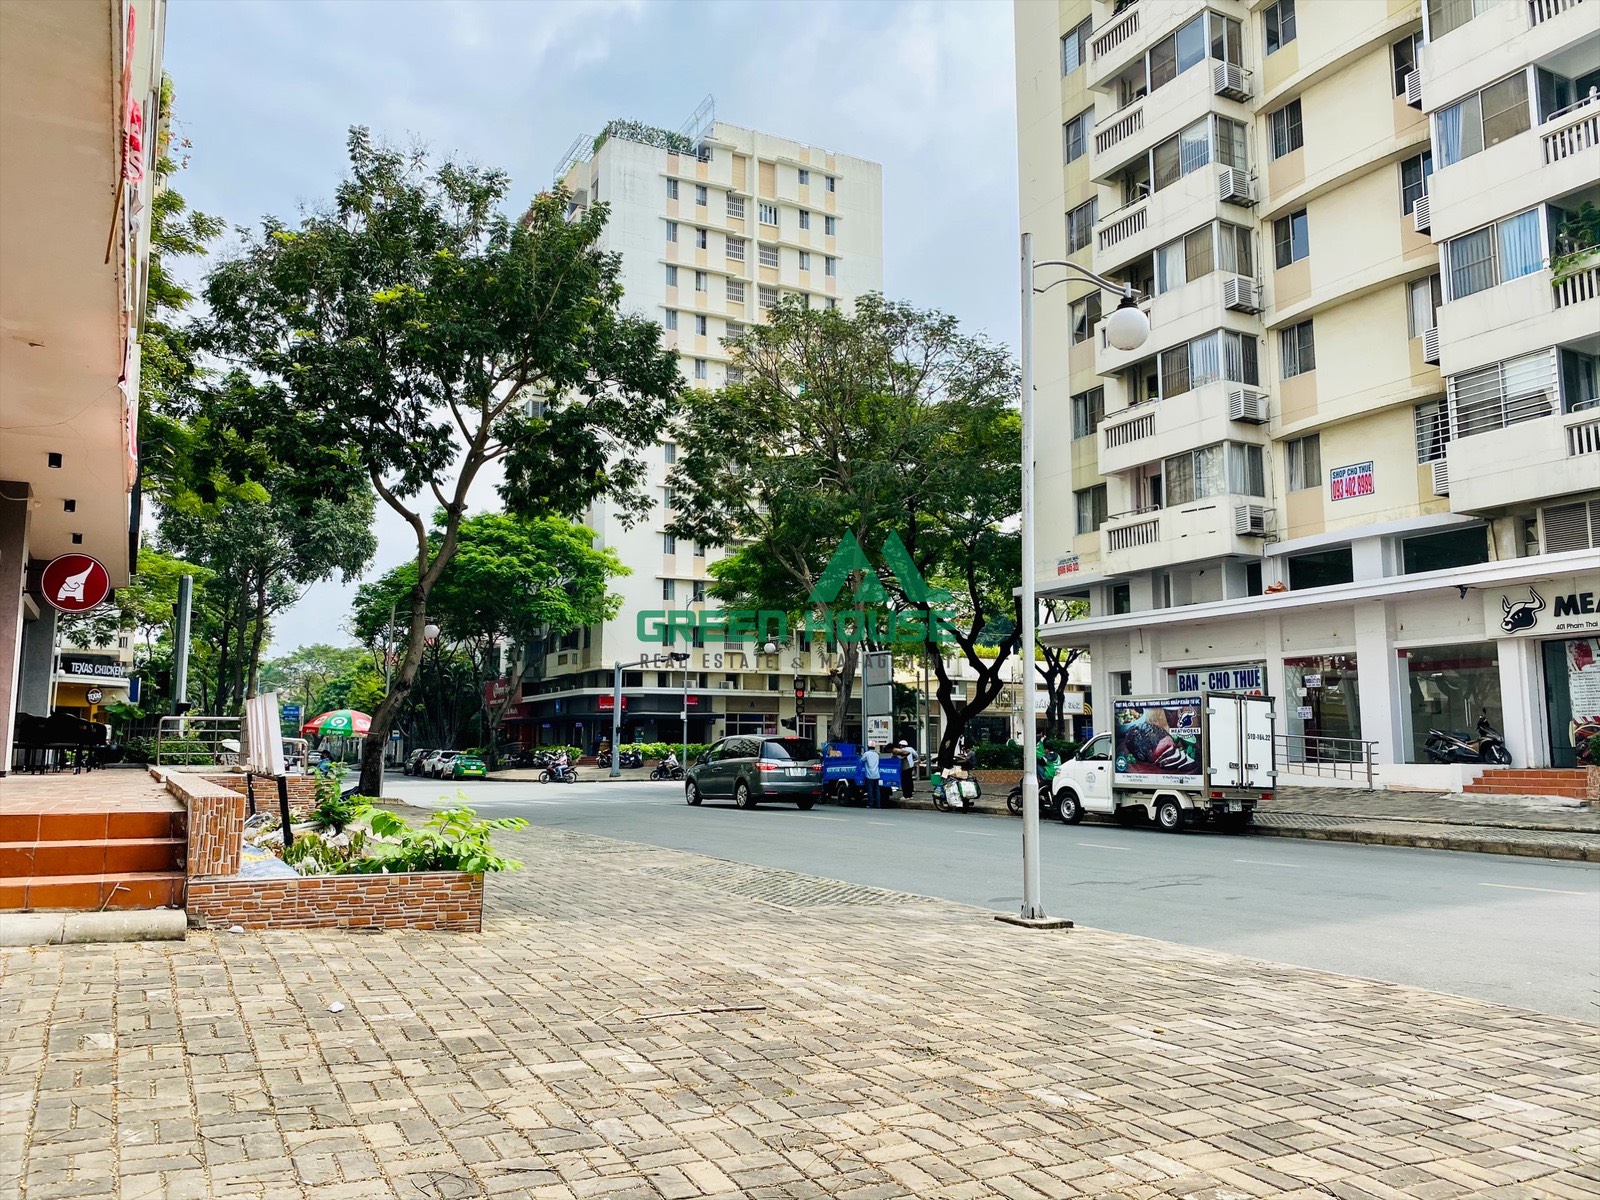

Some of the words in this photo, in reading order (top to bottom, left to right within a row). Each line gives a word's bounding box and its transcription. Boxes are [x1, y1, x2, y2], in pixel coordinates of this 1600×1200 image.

[1333, 470, 1346, 479] SHOP
[1347, 467, 1357, 476] CHO
[1359, 463, 1372, 474] THUÊ
[1333, 479, 1344, 499] 093
[1345, 476, 1356, 497] 402
[1357, 473, 1373, 495] 8989
[1554, 592, 1600, 617] ME
[71, 662, 94, 675] TEXAS
[94, 664, 124, 677] CHICKEN
[1178, 672, 1199, 692] BÁN
[1208, 671, 1230, 691] CHO
[1233, 665, 1261, 689] THUÊ
[87, 692, 102, 701] TEXAS
